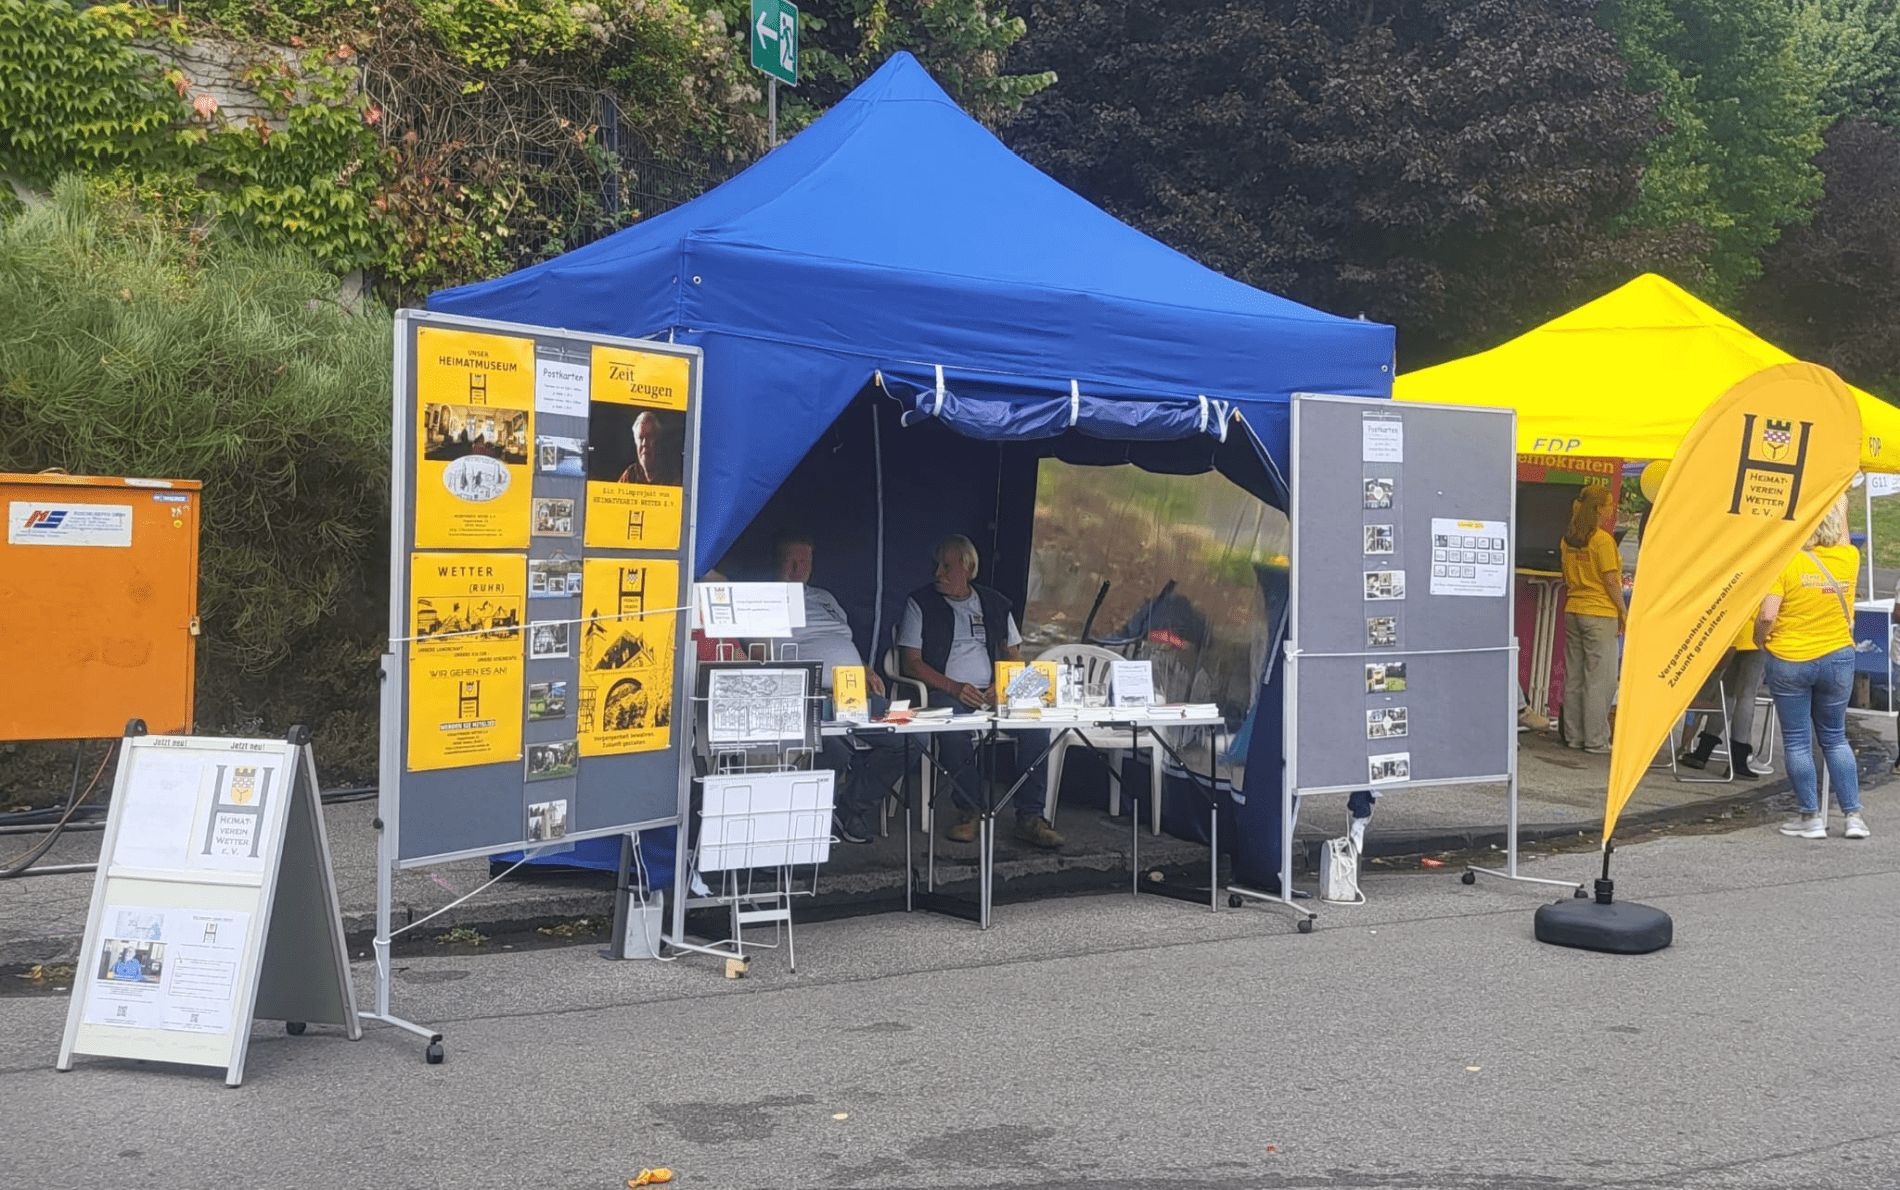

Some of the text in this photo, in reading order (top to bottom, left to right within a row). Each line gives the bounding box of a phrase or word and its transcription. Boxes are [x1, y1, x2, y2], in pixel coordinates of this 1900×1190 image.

[438, 355, 517, 372] HEIMATMUSEUM
[543, 367, 584, 382] Postkarten
[609, 365, 634, 381] Zeit
[630, 383, 673, 399] zeugen
[1533, 438, 1581, 452] FDP
[1517, 453, 1615, 474] emokraten
[1583, 476, 1609, 488] FDP
[1750, 485, 1784, 495] VEREIN
[1745, 495, 1785, 507] WETTER
[438, 566, 494, 577] WETTER
[469, 583, 505, 593] (RUHR)
[1658, 571, 1744, 680] Vergangenheit bewahren.
[1667, 609, 1728, 689] Zukunft gestalten.
[429, 669, 448, 679] WIR
[449, 668, 479, 678] GEHEN
[480, 667, 492, 675] ES
[153, 738, 171, 747] Jetzt
[230, 741, 248, 750] Jetzt
[219, 827, 248, 836] VEREIN
[215, 836, 249, 846] WETTER
